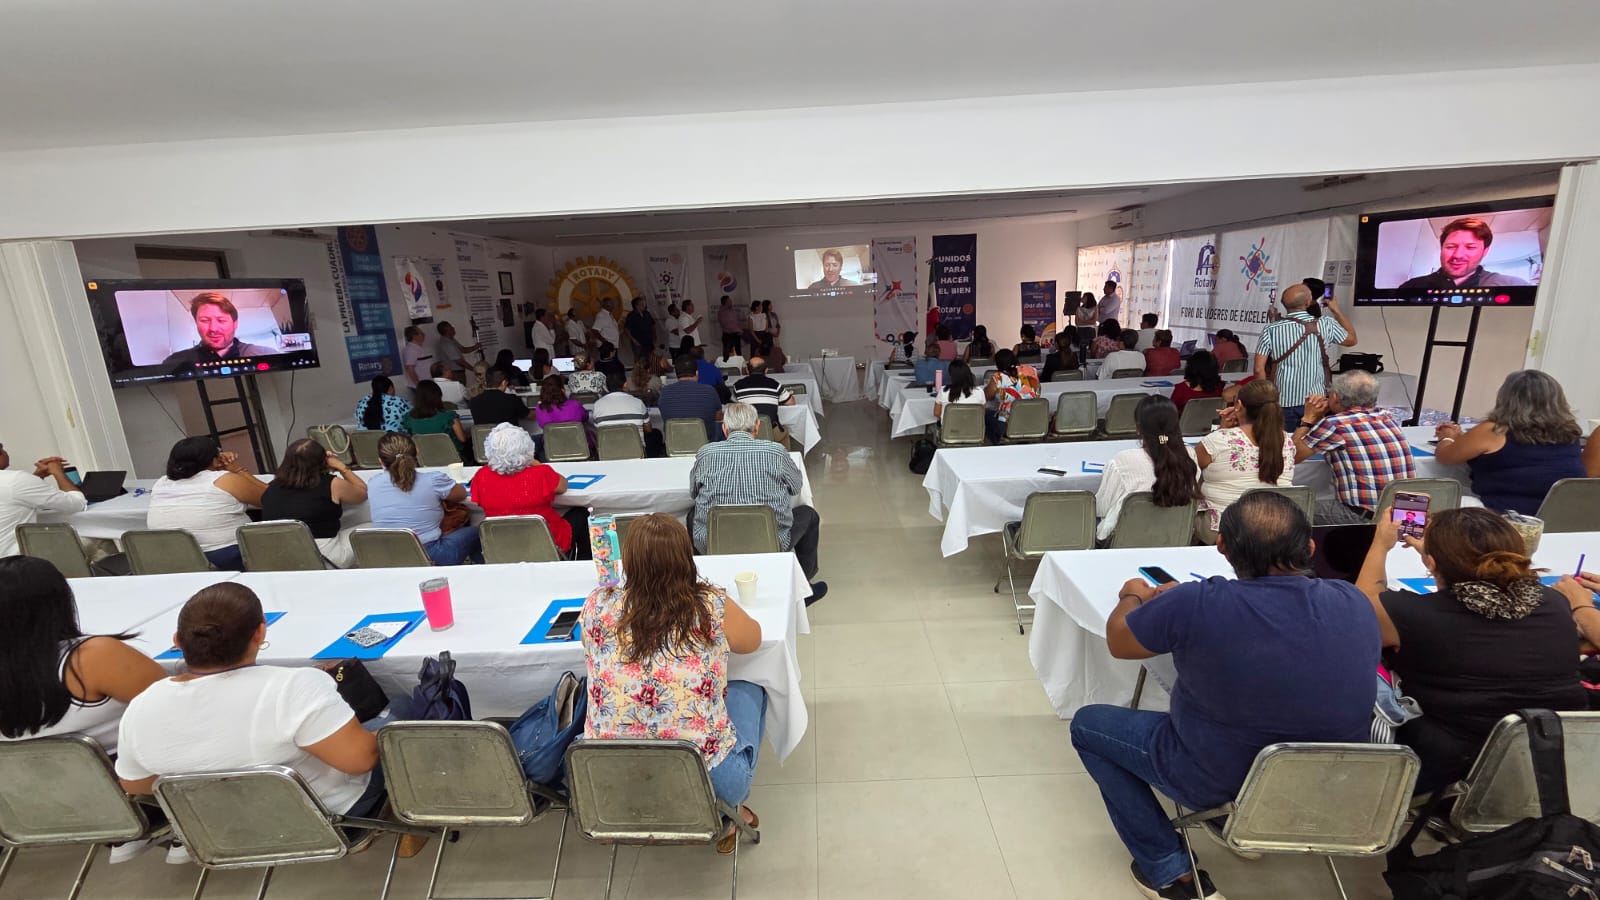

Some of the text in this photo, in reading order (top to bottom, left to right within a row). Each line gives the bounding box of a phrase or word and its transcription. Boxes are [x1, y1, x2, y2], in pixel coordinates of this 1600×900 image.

[938, 254, 971, 262] UNIDOS
[572, 267, 614, 281] ROTARY
[940, 276, 969, 284] HACER
[1194, 277, 1217, 290] Rotary
[938, 287, 949, 295] EL
[334, 282, 348, 319] PRUEBA
[1196, 308, 1204, 319] DE
[1229, 309, 1239, 321] DE
[358, 361, 383, 372] Rotary
